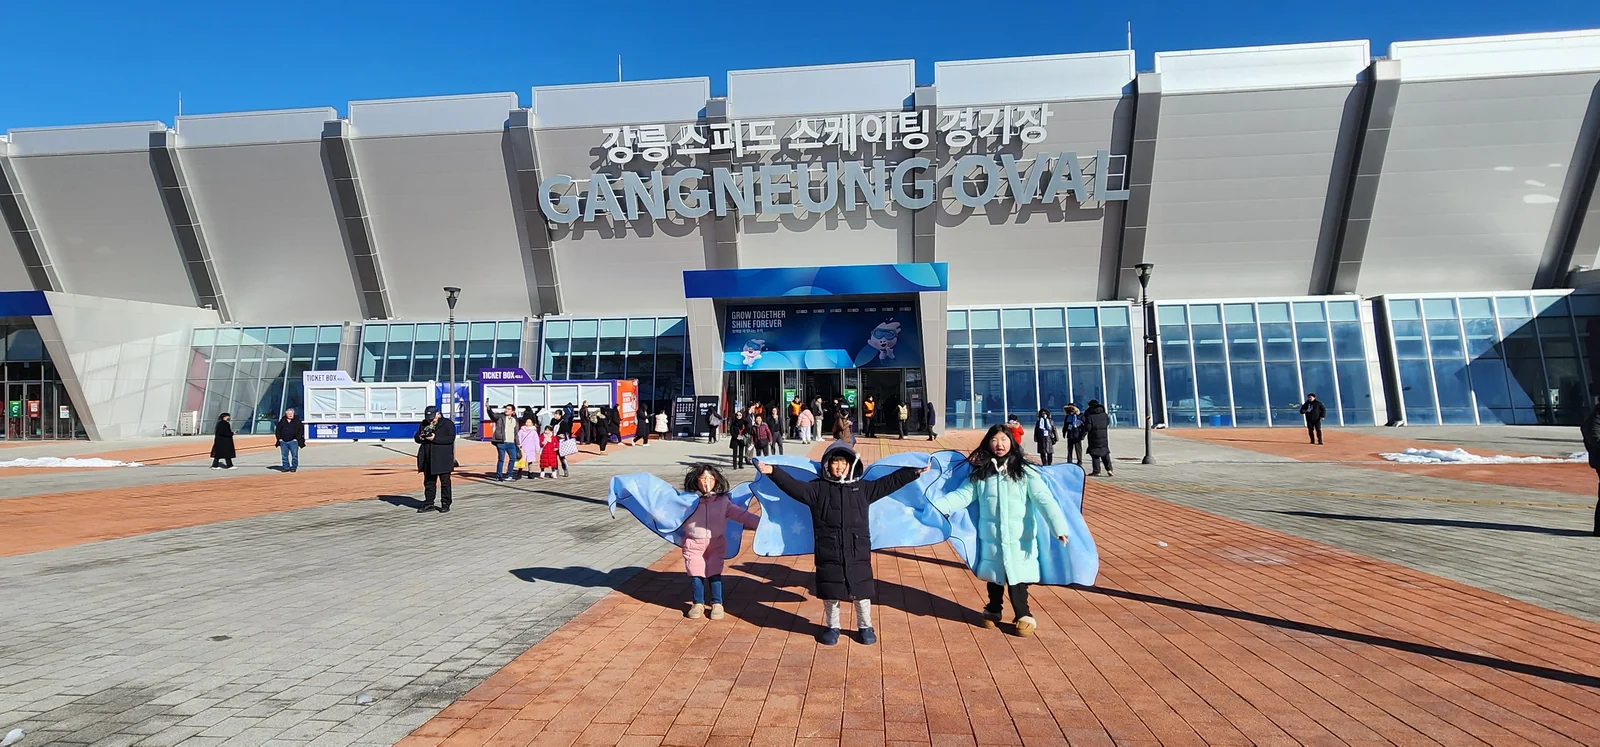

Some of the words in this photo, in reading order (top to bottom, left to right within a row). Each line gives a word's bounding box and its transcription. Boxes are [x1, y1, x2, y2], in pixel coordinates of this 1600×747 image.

[602, 124, 671, 163] 강릉
[677, 120, 780, 158] 스피드
[789, 110, 929, 151] 스케이팅
[941, 103, 1053, 146] 경기장
[538, 157, 936, 223] GANGNEUNG
[952, 150, 1130, 207] OVAL
[731, 311, 752, 319] GROW
[753, 310, 786, 319] TOGETHER
[731, 320, 752, 328] SHINE
[753, 319, 782, 328] FOREVER
[482, 371, 502, 379] TICKET
[503, 371, 515, 379] BOX
